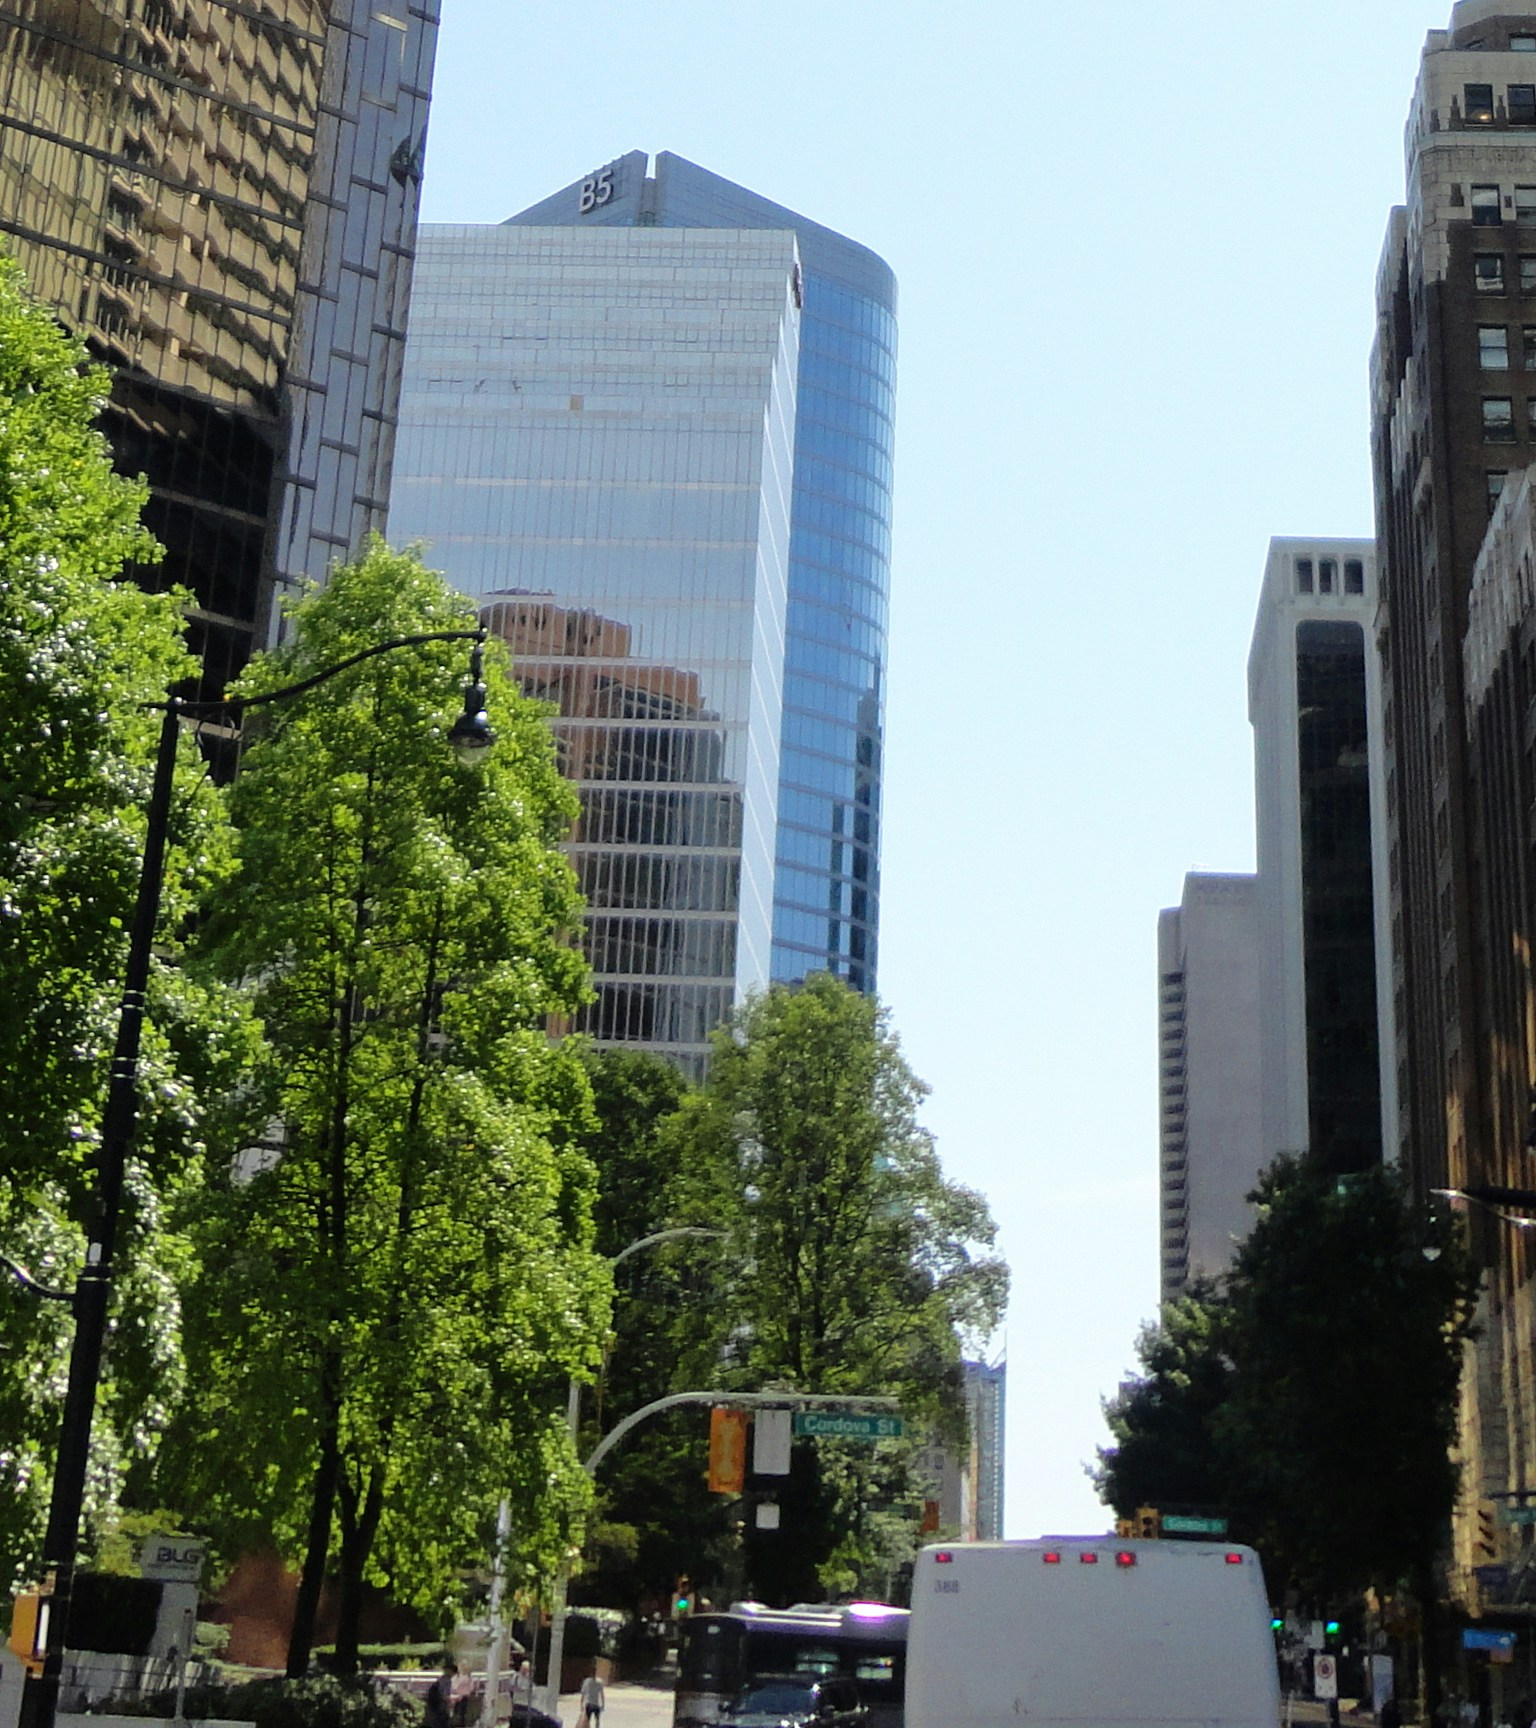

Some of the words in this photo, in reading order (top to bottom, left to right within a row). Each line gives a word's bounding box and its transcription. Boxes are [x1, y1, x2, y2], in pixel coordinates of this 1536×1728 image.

[579, 170, 612, 212] B5
[804, 1415, 870, 1432] Cordova
[876, 1418, 896, 1434] St
